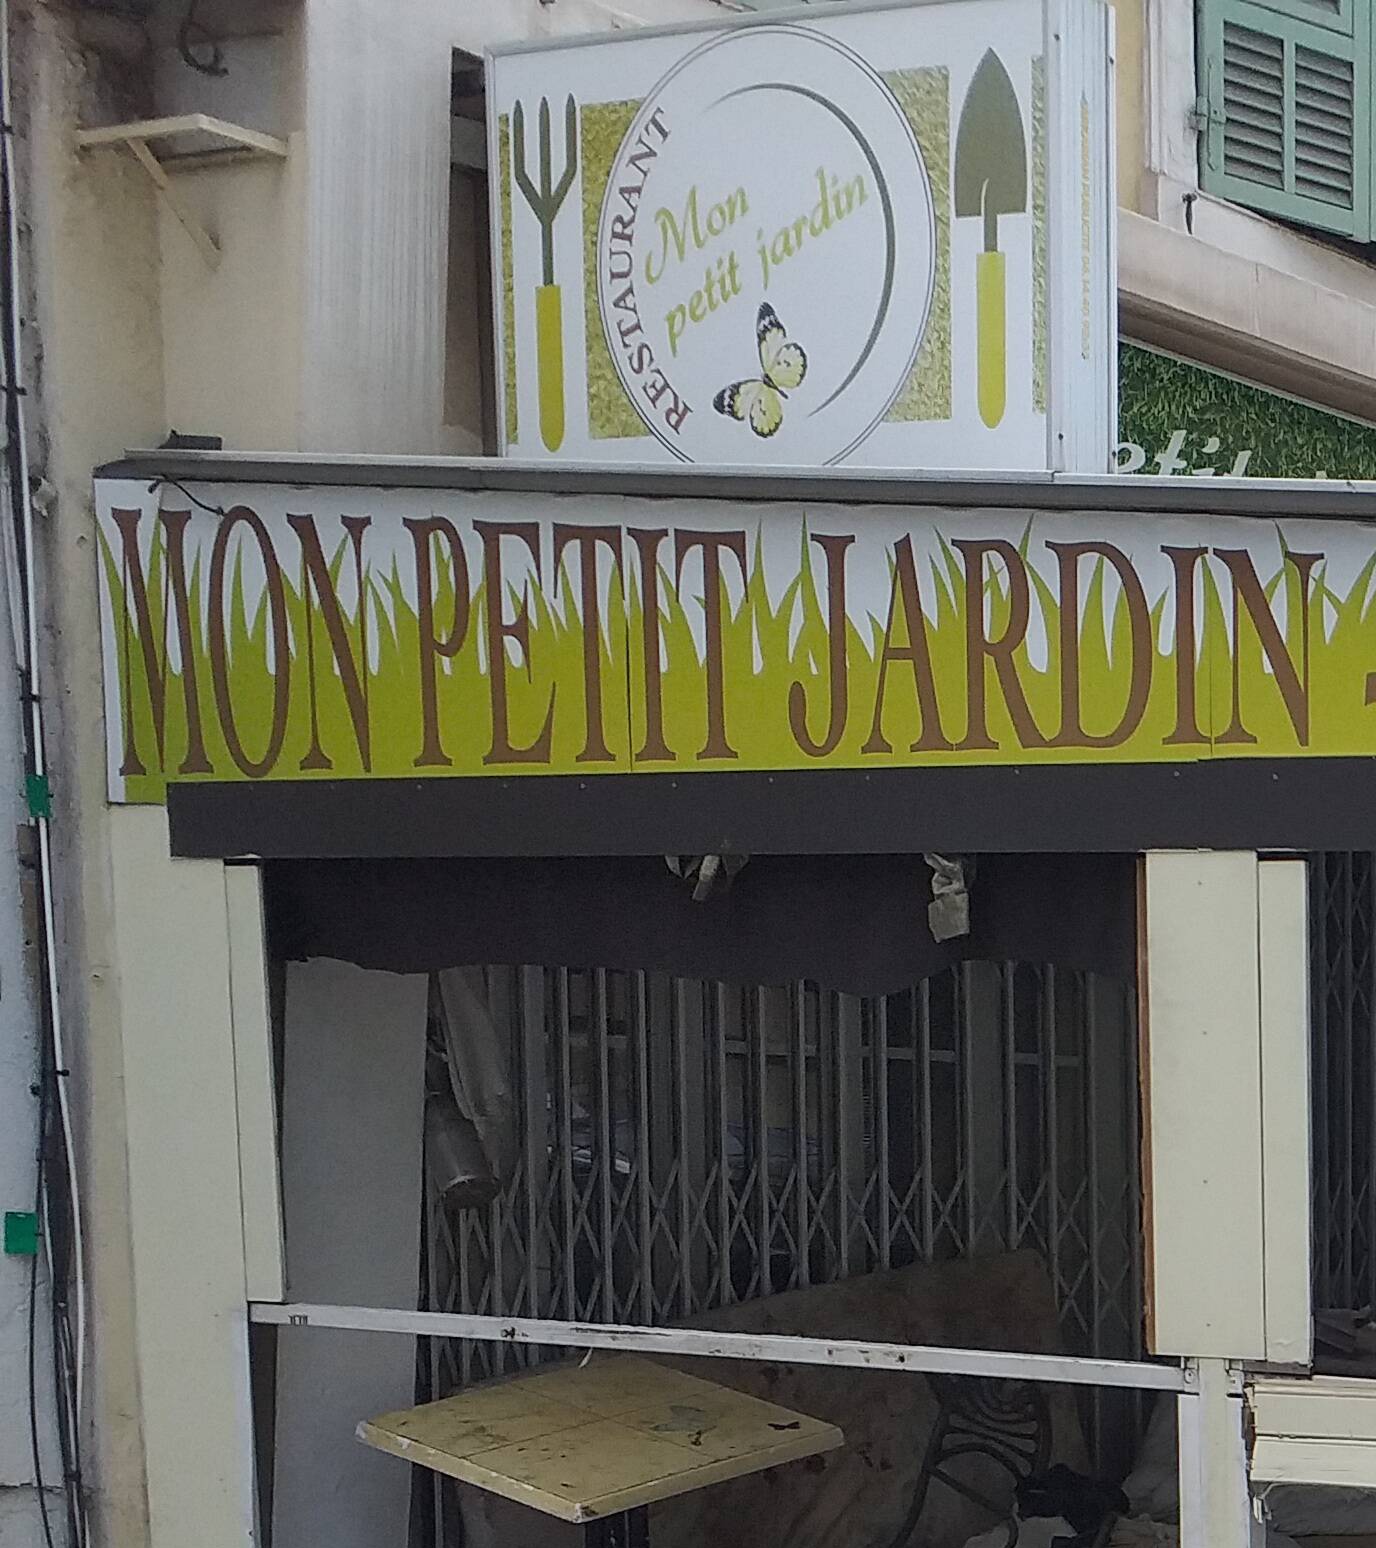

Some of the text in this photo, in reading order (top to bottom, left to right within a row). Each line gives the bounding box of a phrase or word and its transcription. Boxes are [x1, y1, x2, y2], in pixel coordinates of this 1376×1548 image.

[607, 106, 694, 435] RESTAURANT
[645, 185, 750, 286] Mon
[663, 165, 870, 357] petit jardin
[111, 504, 373, 778] MON
[402, 514, 749, 767] PETIT
[788, 532, 1325, 758] JARDIN
